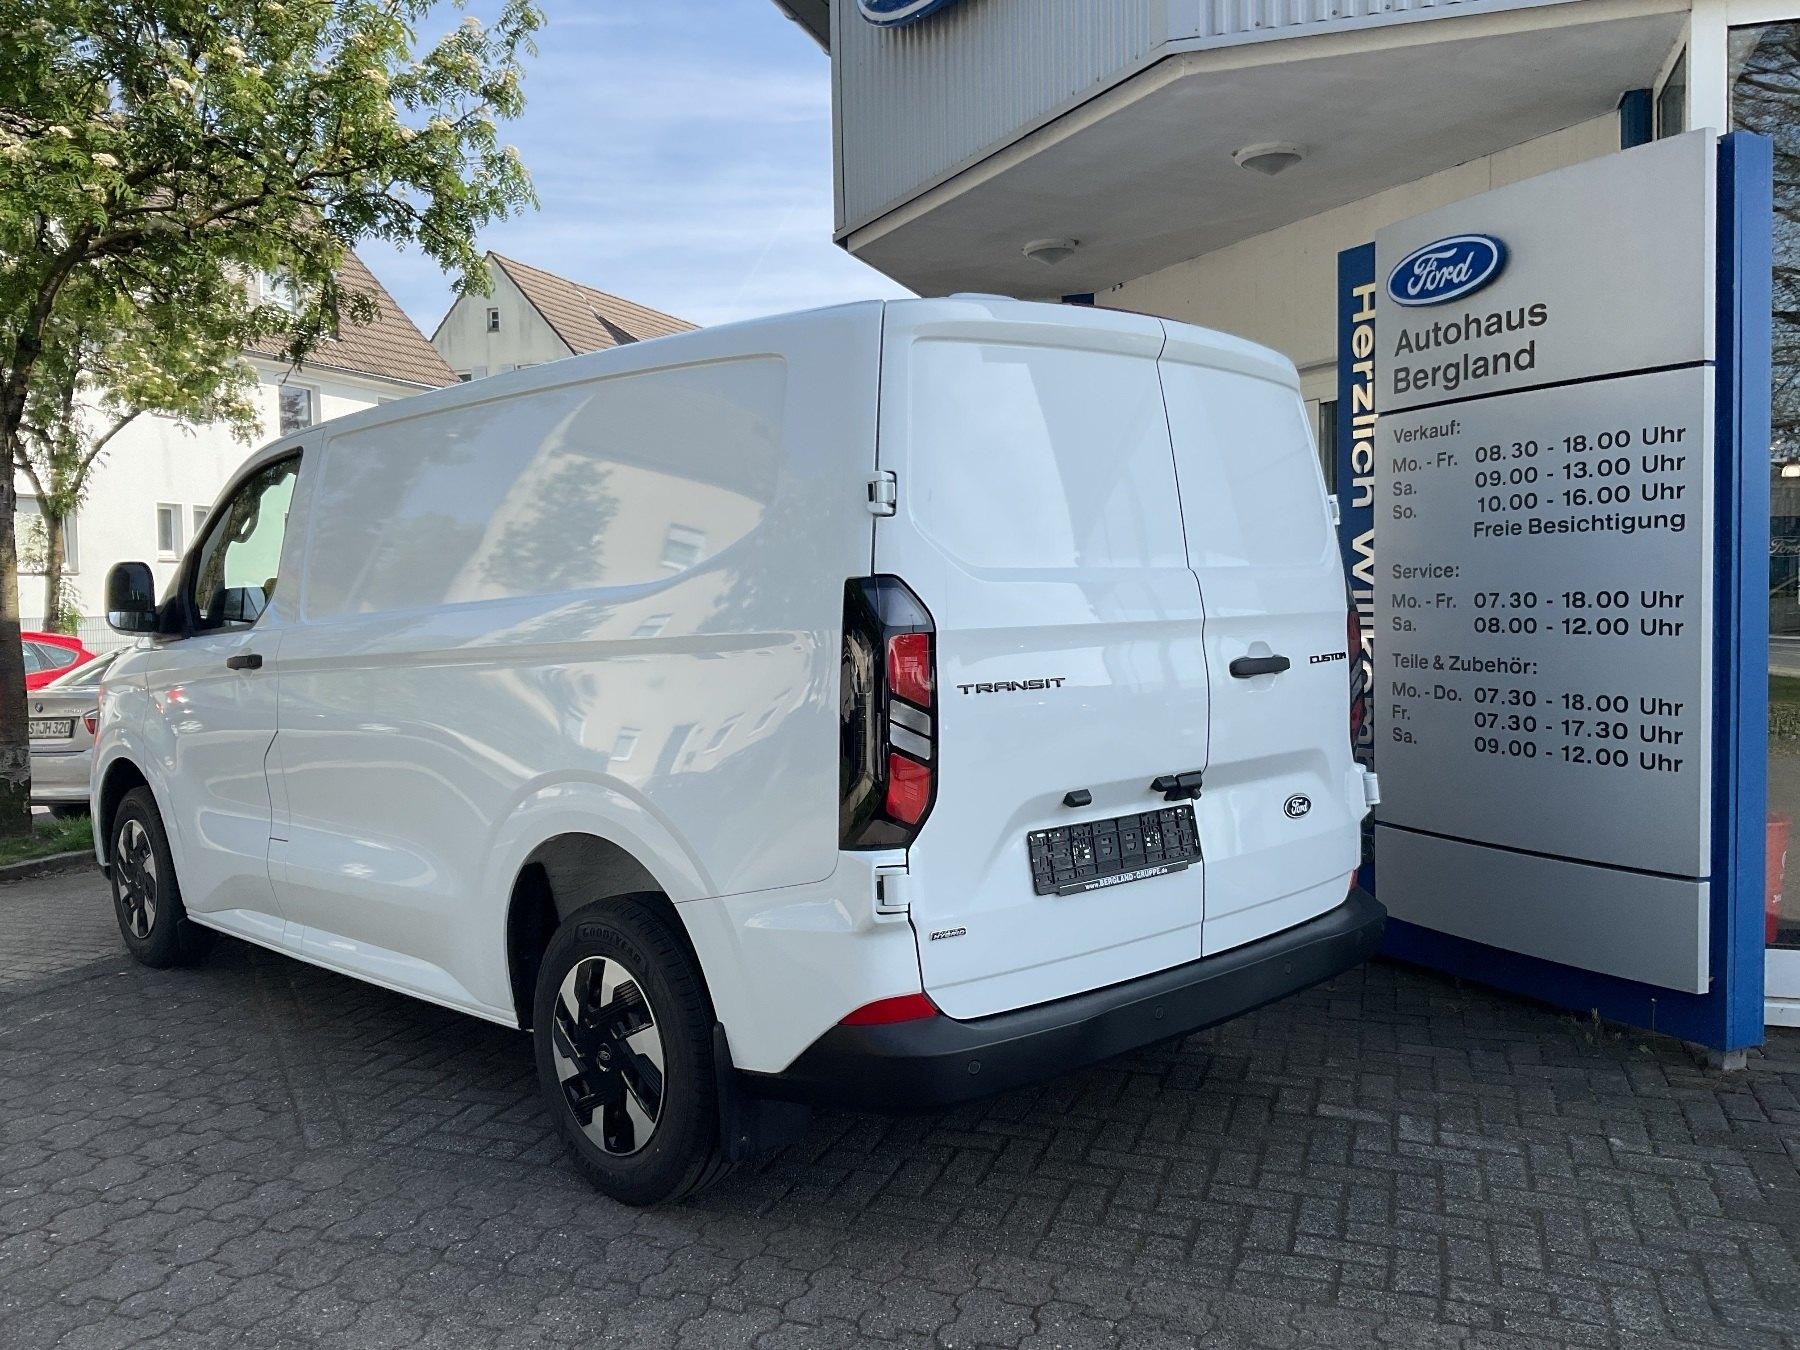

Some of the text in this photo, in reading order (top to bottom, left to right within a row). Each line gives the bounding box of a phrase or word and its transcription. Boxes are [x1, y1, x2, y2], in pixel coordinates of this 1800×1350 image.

[1407, 248, 1475, 296] Ford
[1394, 303, 1548, 357] Autohaus
[1393, 340, 1535, 394] Bergland
[1352, 283, 1376, 507] Herzlich
[1392, 457, 1422, 474] Mo.
[1436, 451, 1458, 468] Fr.
[1475, 440, 1539, 463] 08.30
[1562, 430, 1631, 453] 18.00
[1642, 426, 1686, 445] Uhr
[1393, 420, 1461, 444] Verkauf:
[1392, 481, 1417, 497] Sa.
[1475, 466, 1538, 488] 09.00
[1562, 457, 1631, 480] 13.00
[1642, 454, 1686, 473] Uhr
[1392, 504, 1417, 520] So.
[1477, 492, 1538, 513] 10.00
[1562, 485, 1631, 507] 16.00
[1641, 482, 1686, 501] Uhr
[1473, 512, 1686, 538] Freie Besichtigung
[1392, 563, 1460, 580] Service:
[1391, 593, 1421, 609] Mo.
[1435, 592, 1457, 609] Fr.
[1473, 591, 1538, 609] 07.30
[1562, 590, 1630, 609] 18.00
[1640, 590, 1685, 608] Uhr
[1392, 616, 1417, 632] Sa.
[1473, 616, 1538, 634] 08.00
[1561, 617, 1630, 636] 12.00
[1640, 618, 1685, 637] Uhr
[1309, 651, 1347, 665] CUSTOM
[1392, 652, 1538, 675] Teile & Zubehör:
[956, 677, 1066, 695] TRANSIT
[1391, 681, 1421, 699] Mo.
[1433, 684, 1462, 702] Do.
[1474, 687, 1537, 707] 07.30
[1561, 692, 1629, 714] 18.00
[1640, 697, 1684, 717] Uhr
[39, 721, 52, 735] JH
[1392, 704, 1411, 720] Fr.
[1474, 711, 1537, 733] 07.30
[1561, 719, 1629, 740] 17.30
[1640, 724, 1684, 745] Uhr
[1392, 727, 1418, 745] Sa.
[1474, 736, 1537, 758] 09.00
[1561, 745, 1629, 768] 12.00
[1640, 751, 1684, 773] Uhr
